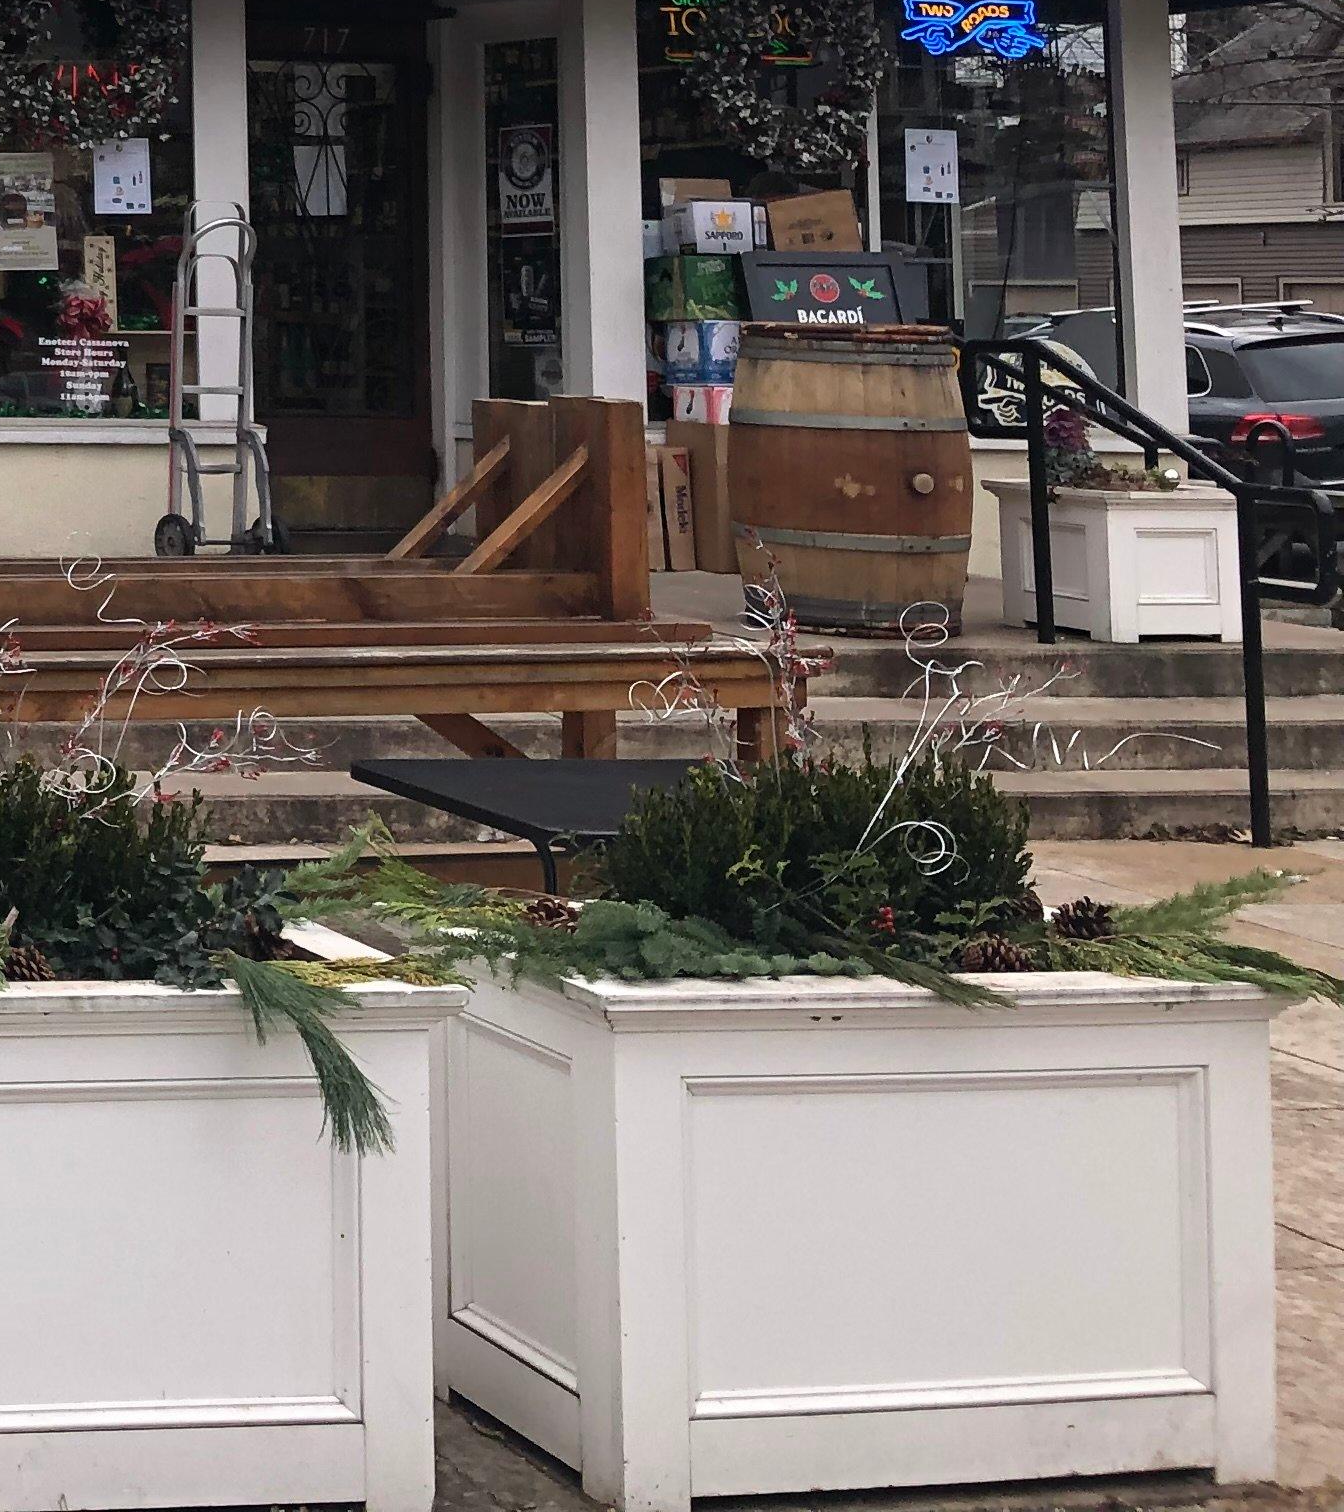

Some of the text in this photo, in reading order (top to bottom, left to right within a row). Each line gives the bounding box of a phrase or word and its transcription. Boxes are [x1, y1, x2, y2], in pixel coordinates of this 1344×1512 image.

[918, 3, 1010, 34] TWO ROADS
[303, 27, 350, 55] 717
[505, 192, 546, 209] NOW
[704, 230, 744, 241] SAPPORO
[38, 336, 130, 348] Enoteca Cassanova
[54, 347, 114, 357] Store Hours
[65, 381, 103, 392] Sunday
